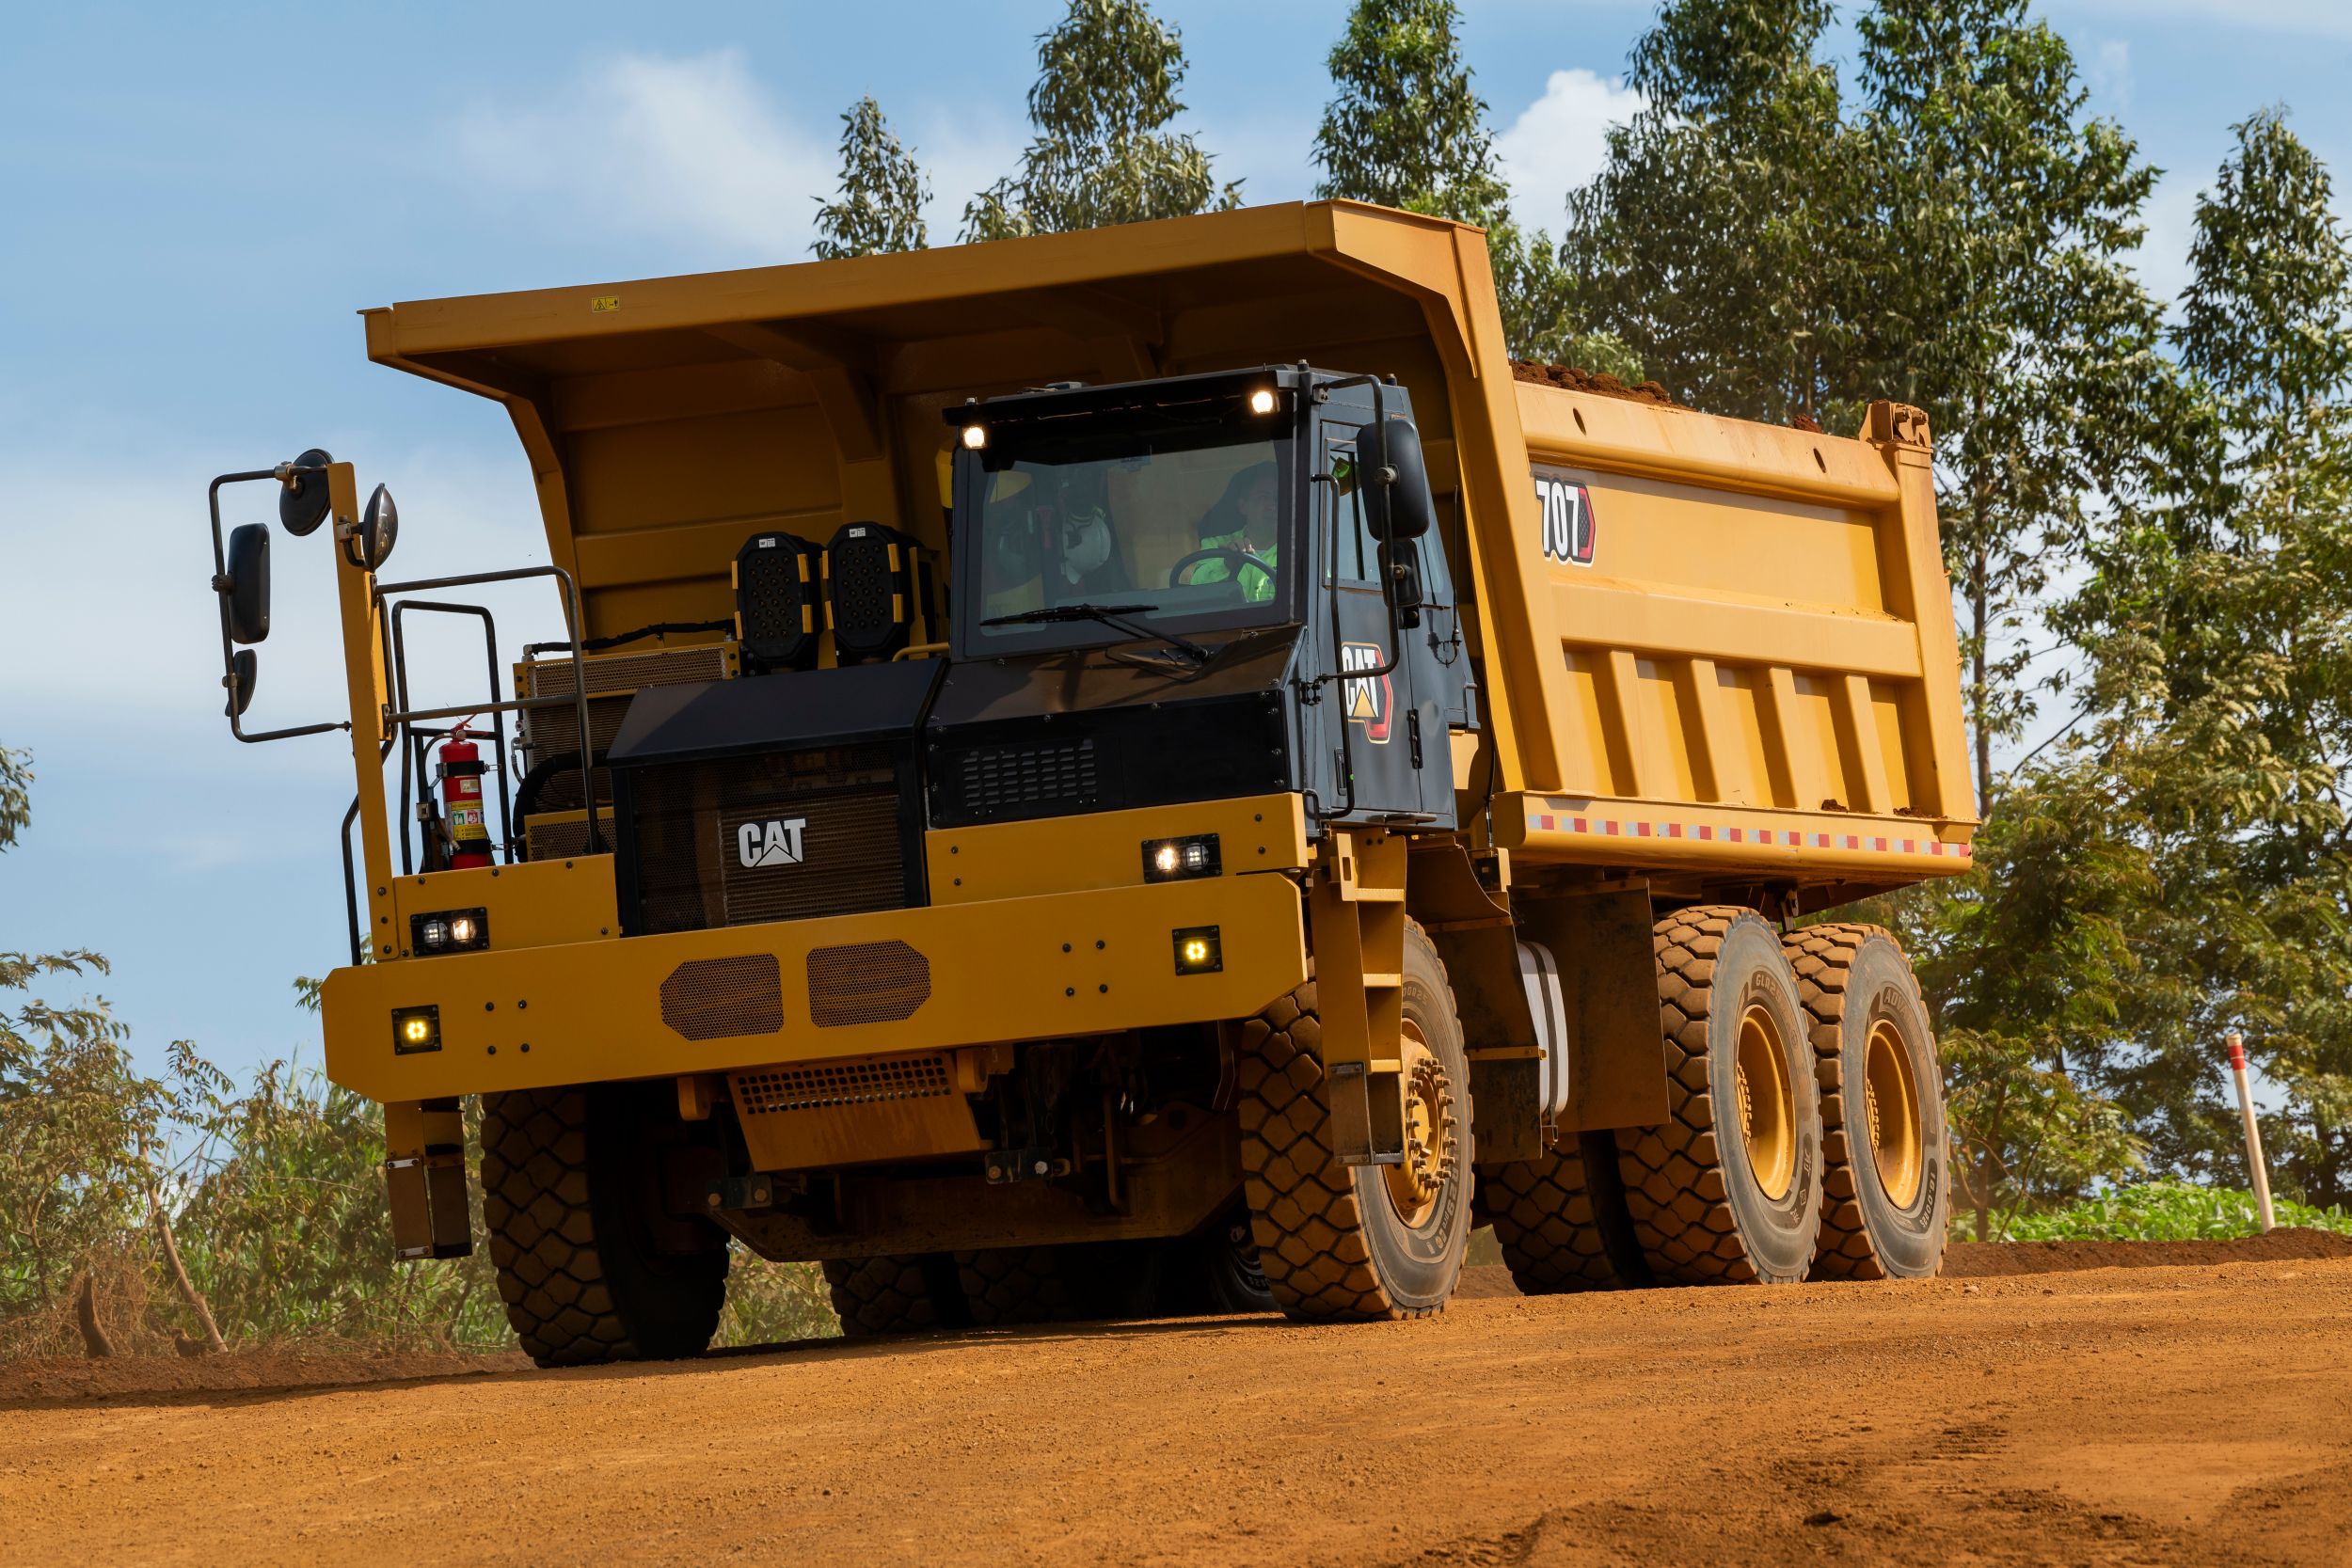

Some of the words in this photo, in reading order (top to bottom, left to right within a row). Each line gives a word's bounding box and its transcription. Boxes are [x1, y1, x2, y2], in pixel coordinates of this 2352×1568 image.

[1536, 480, 1580, 557] 707
[1342, 646, 1379, 718] CAT
[739, 818, 806, 867] CAT
